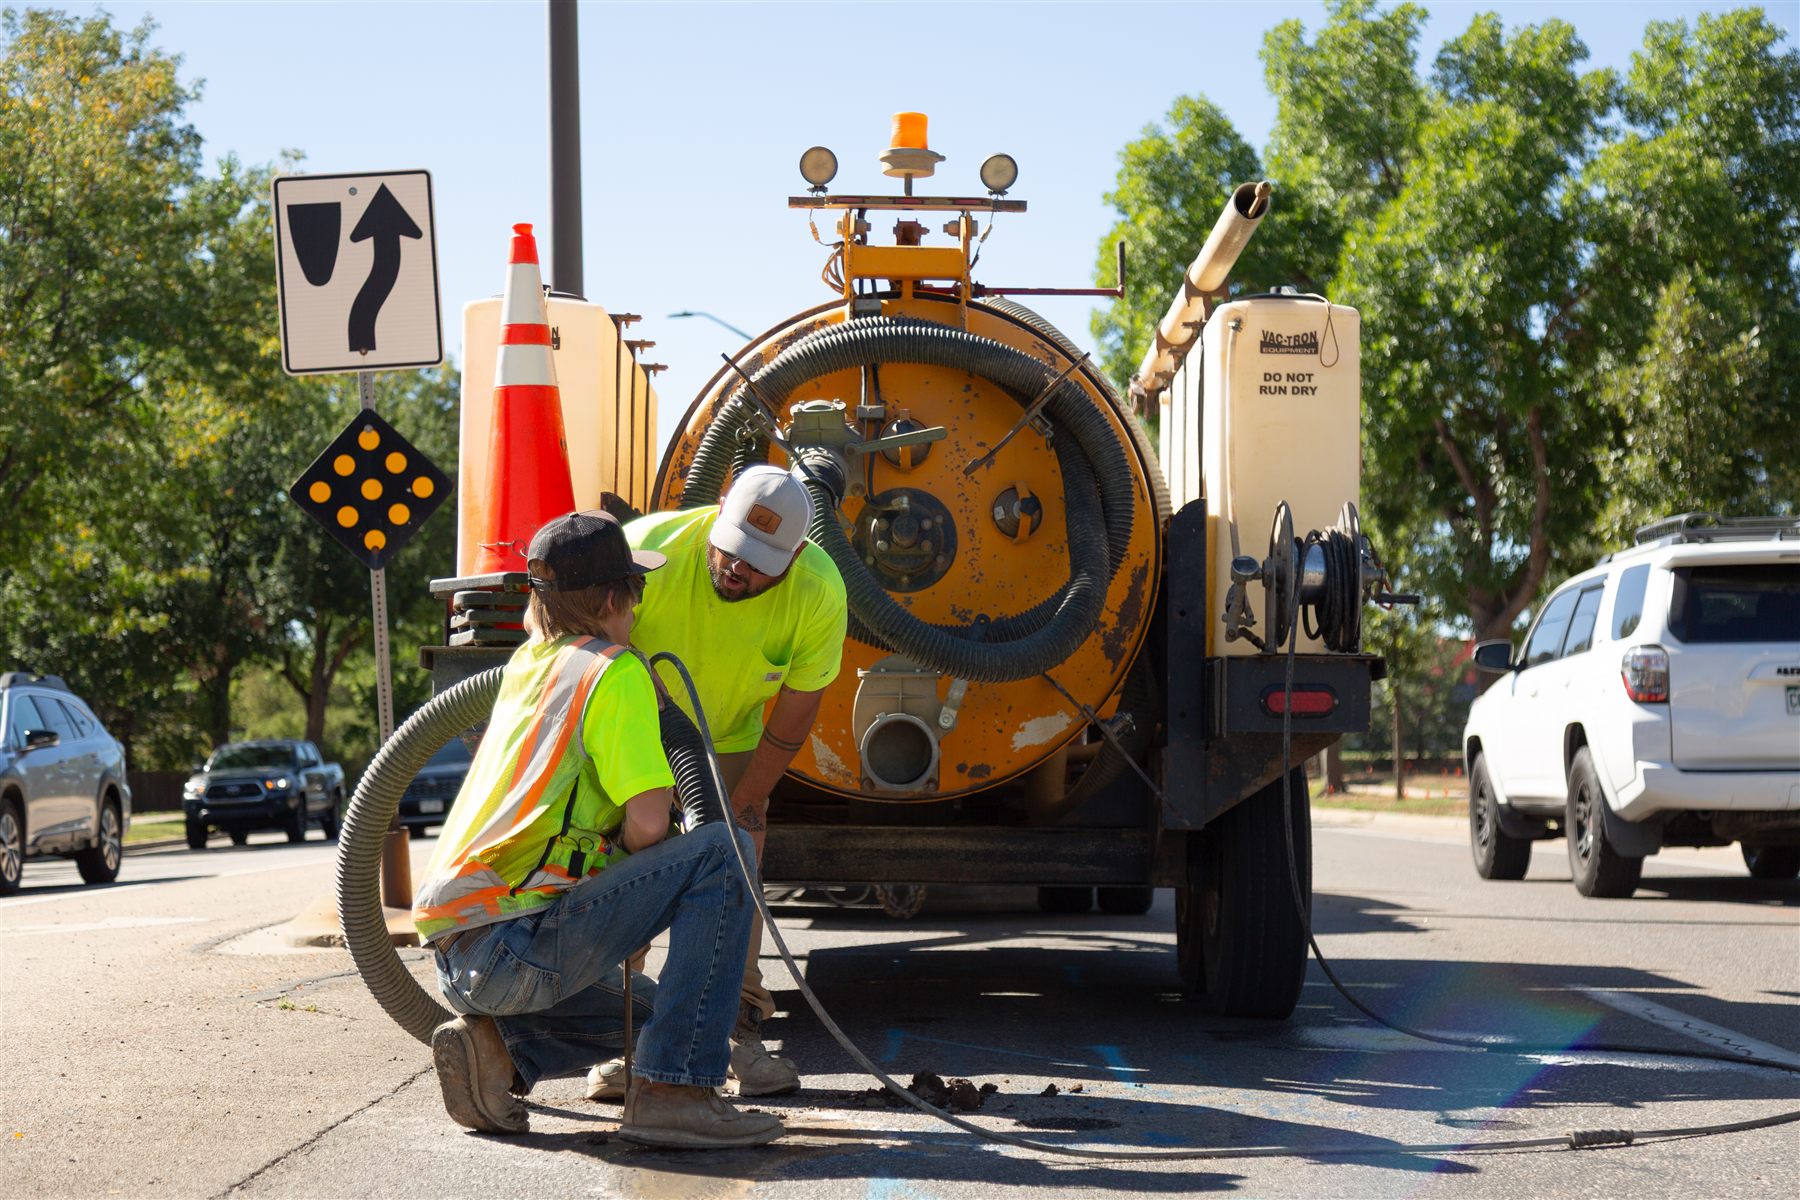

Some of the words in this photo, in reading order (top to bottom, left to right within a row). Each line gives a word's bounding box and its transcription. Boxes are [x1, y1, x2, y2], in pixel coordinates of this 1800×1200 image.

[1261, 329, 1317, 347] VAC-TRON
[1263, 372, 1282, 383] DO
[1286, 373, 1314, 383] NOT
[1259, 385, 1287, 396] RUN
[1291, 386, 1318, 396] DRY
